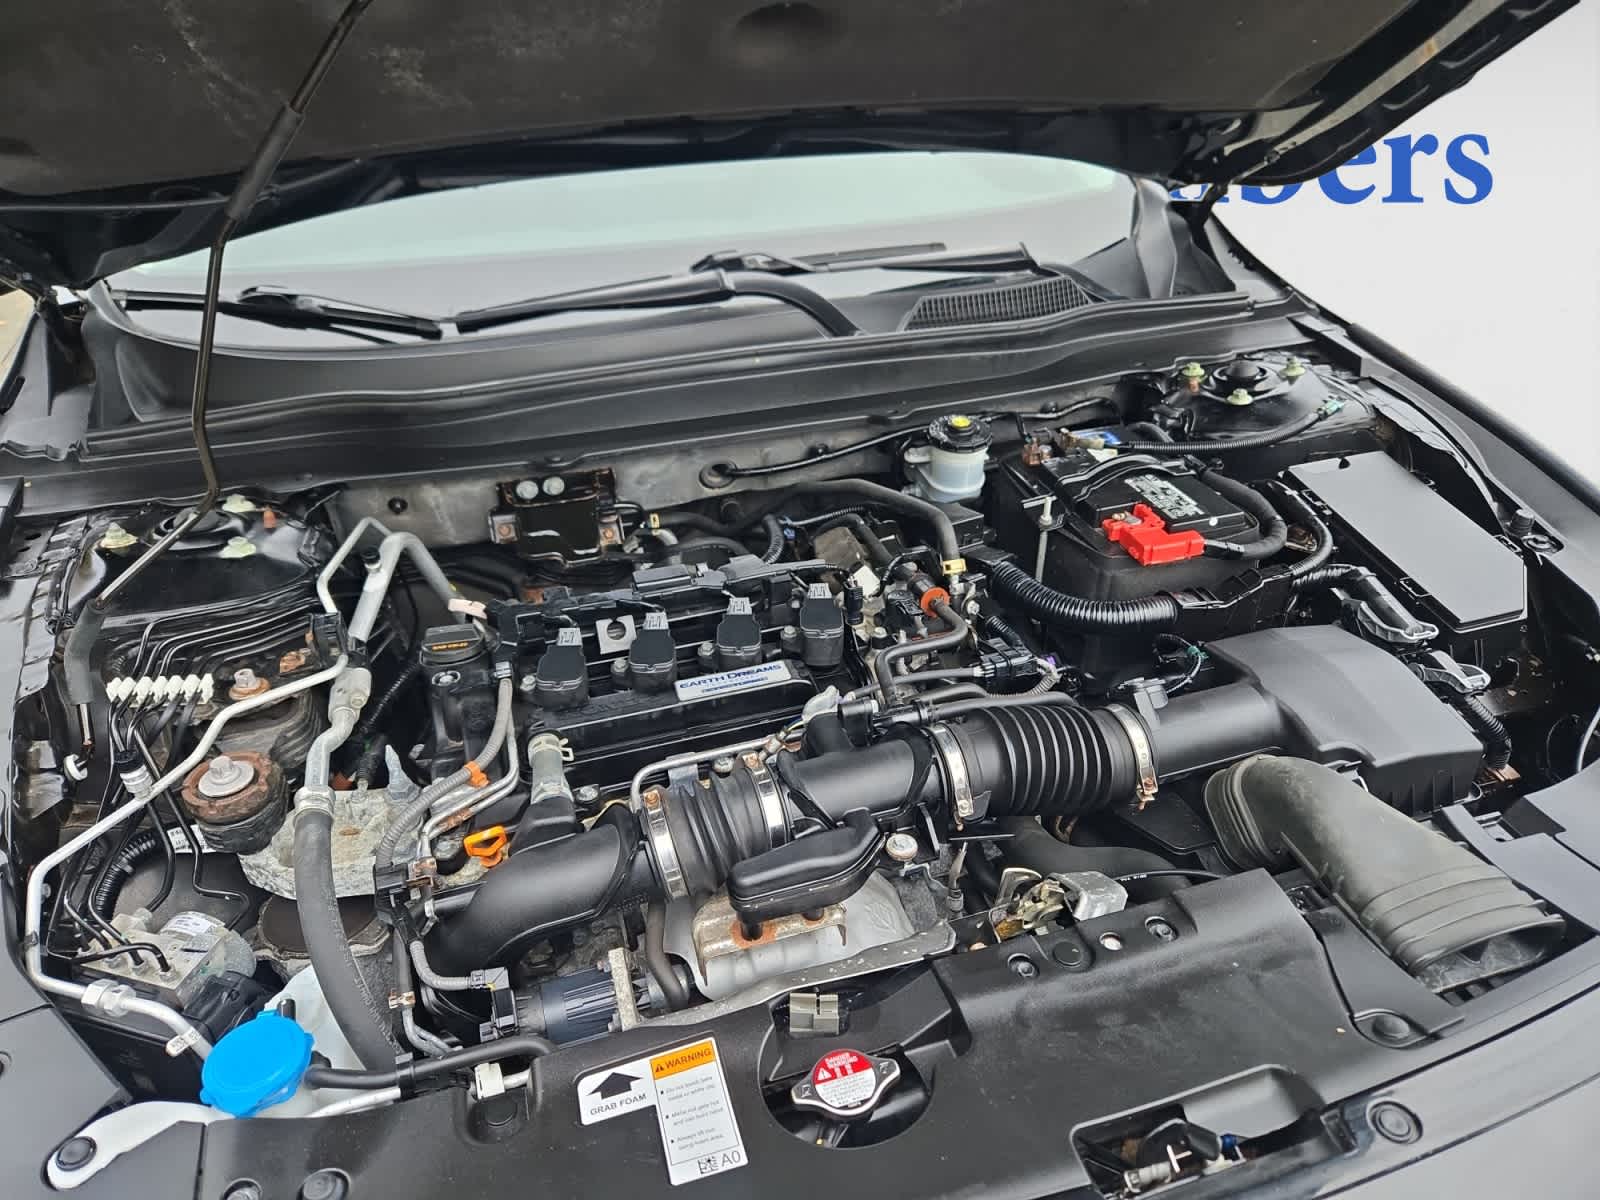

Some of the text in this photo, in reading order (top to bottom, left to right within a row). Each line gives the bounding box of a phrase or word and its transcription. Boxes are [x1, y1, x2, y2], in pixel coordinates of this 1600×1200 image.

[680, 675, 725, 689] EARTH
[727, 664, 782, 679] DREAMS
[665, 1048, 711, 1068] WARNING
[590, 1093, 647, 1115] GRAB FOAM
